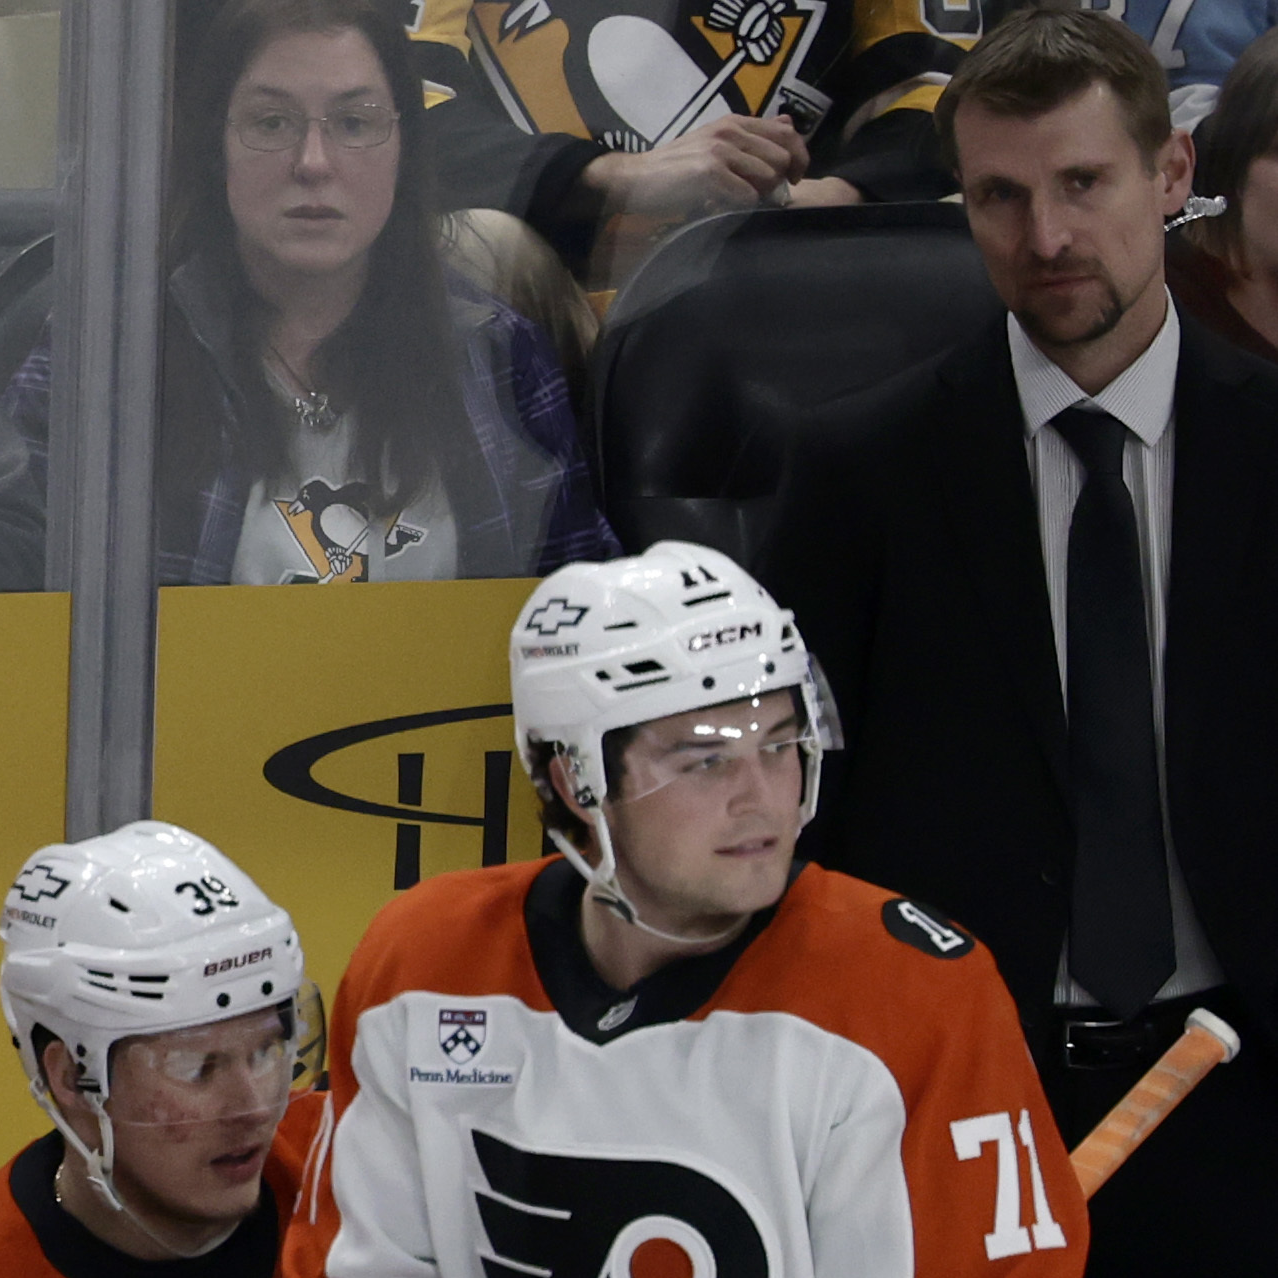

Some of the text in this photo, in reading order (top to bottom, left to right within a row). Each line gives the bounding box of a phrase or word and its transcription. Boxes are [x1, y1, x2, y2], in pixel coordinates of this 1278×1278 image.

[689, 622, 763, 651] CCM
[175, 875, 239, 916] 39
[203, 948, 273, 977] BAUER
[410, 1066, 513, 1085] Penn Medicine
[949, 1109, 1067, 1263] 71
